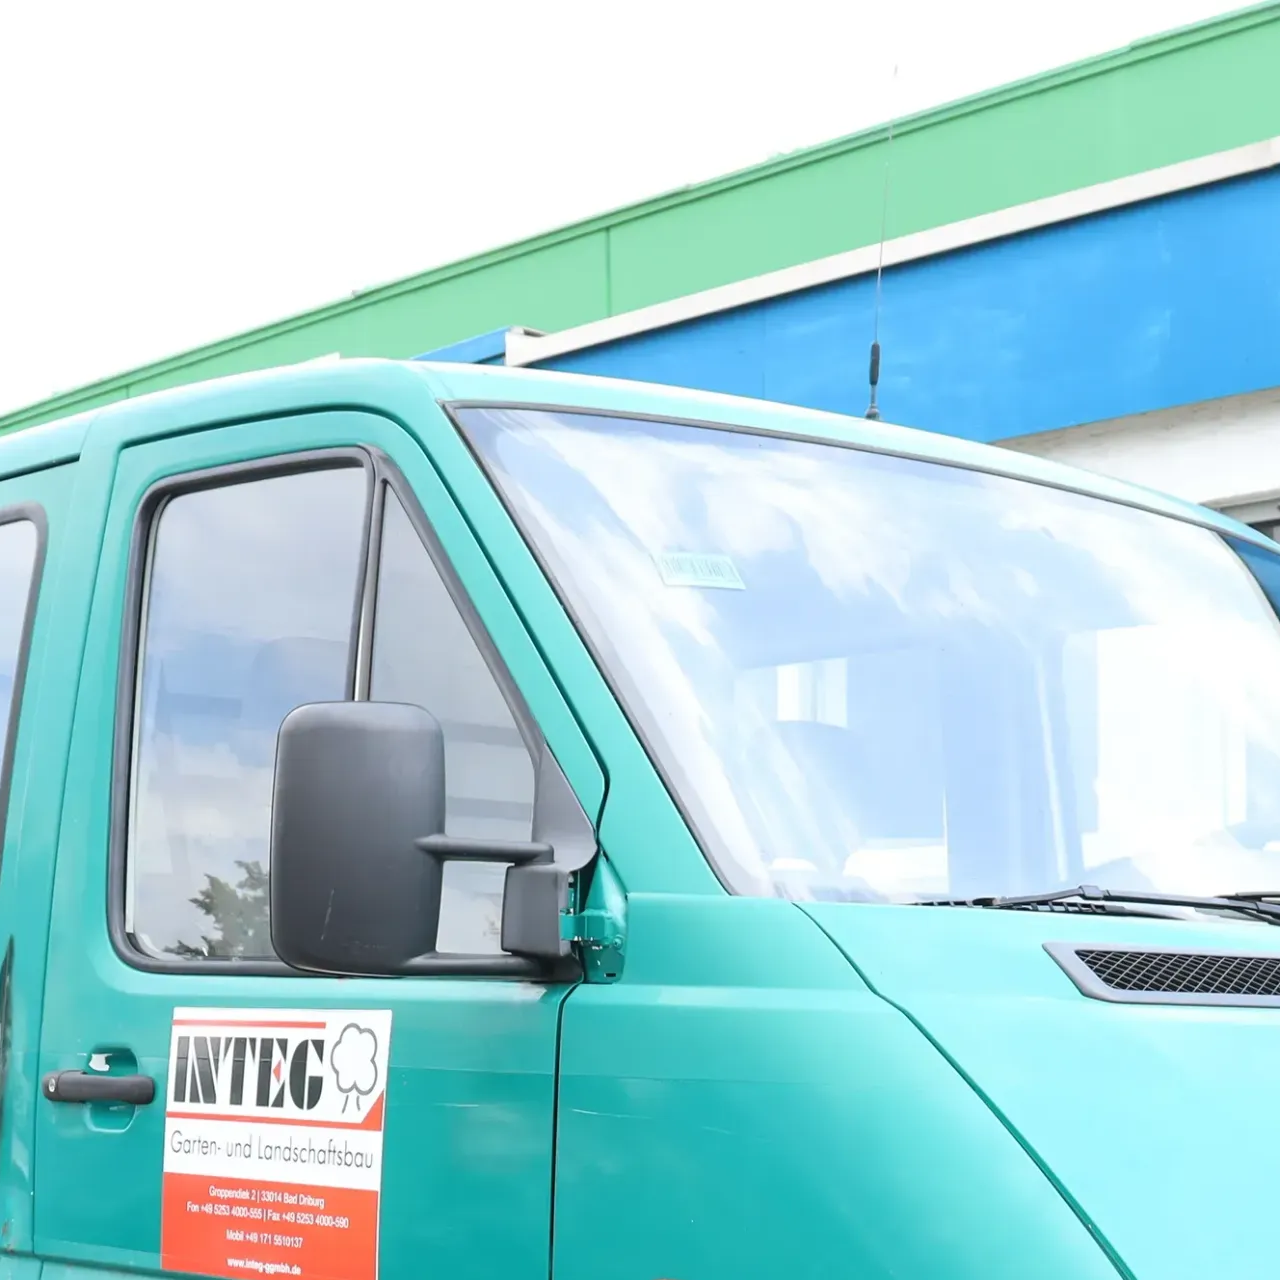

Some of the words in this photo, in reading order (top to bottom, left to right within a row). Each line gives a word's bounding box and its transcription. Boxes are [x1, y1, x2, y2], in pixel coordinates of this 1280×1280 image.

[173, 1036, 325, 1110] INTEG
[170, 1129, 222, 1155] Garten-
[226, 1134, 253, 1159] und
[257, 1136, 374, 1169] Landschaftsbau
[250, 1189, 256, 1200] 2
[261, 1190, 282, 1203] 33014
[283, 1192, 298, 1205] Bad
[298, 1193, 325, 1210] Driburg
[186, 1201, 200, 1213] Fon
[200, 1203, 213, 1215] +49
[213, 1204, 230, 1216] 5253
[267, 1209, 281, 1221] Fax
[281, 1212, 296, 1223] +49
[296, 1212, 314, 1225] 5253
[315, 1214, 349, 1229] 4000-590
[226, 1229, 244, 1242] Mobil
[245, 1231, 259, 1244] +49
[259, 1233, 272, 1245] 171
